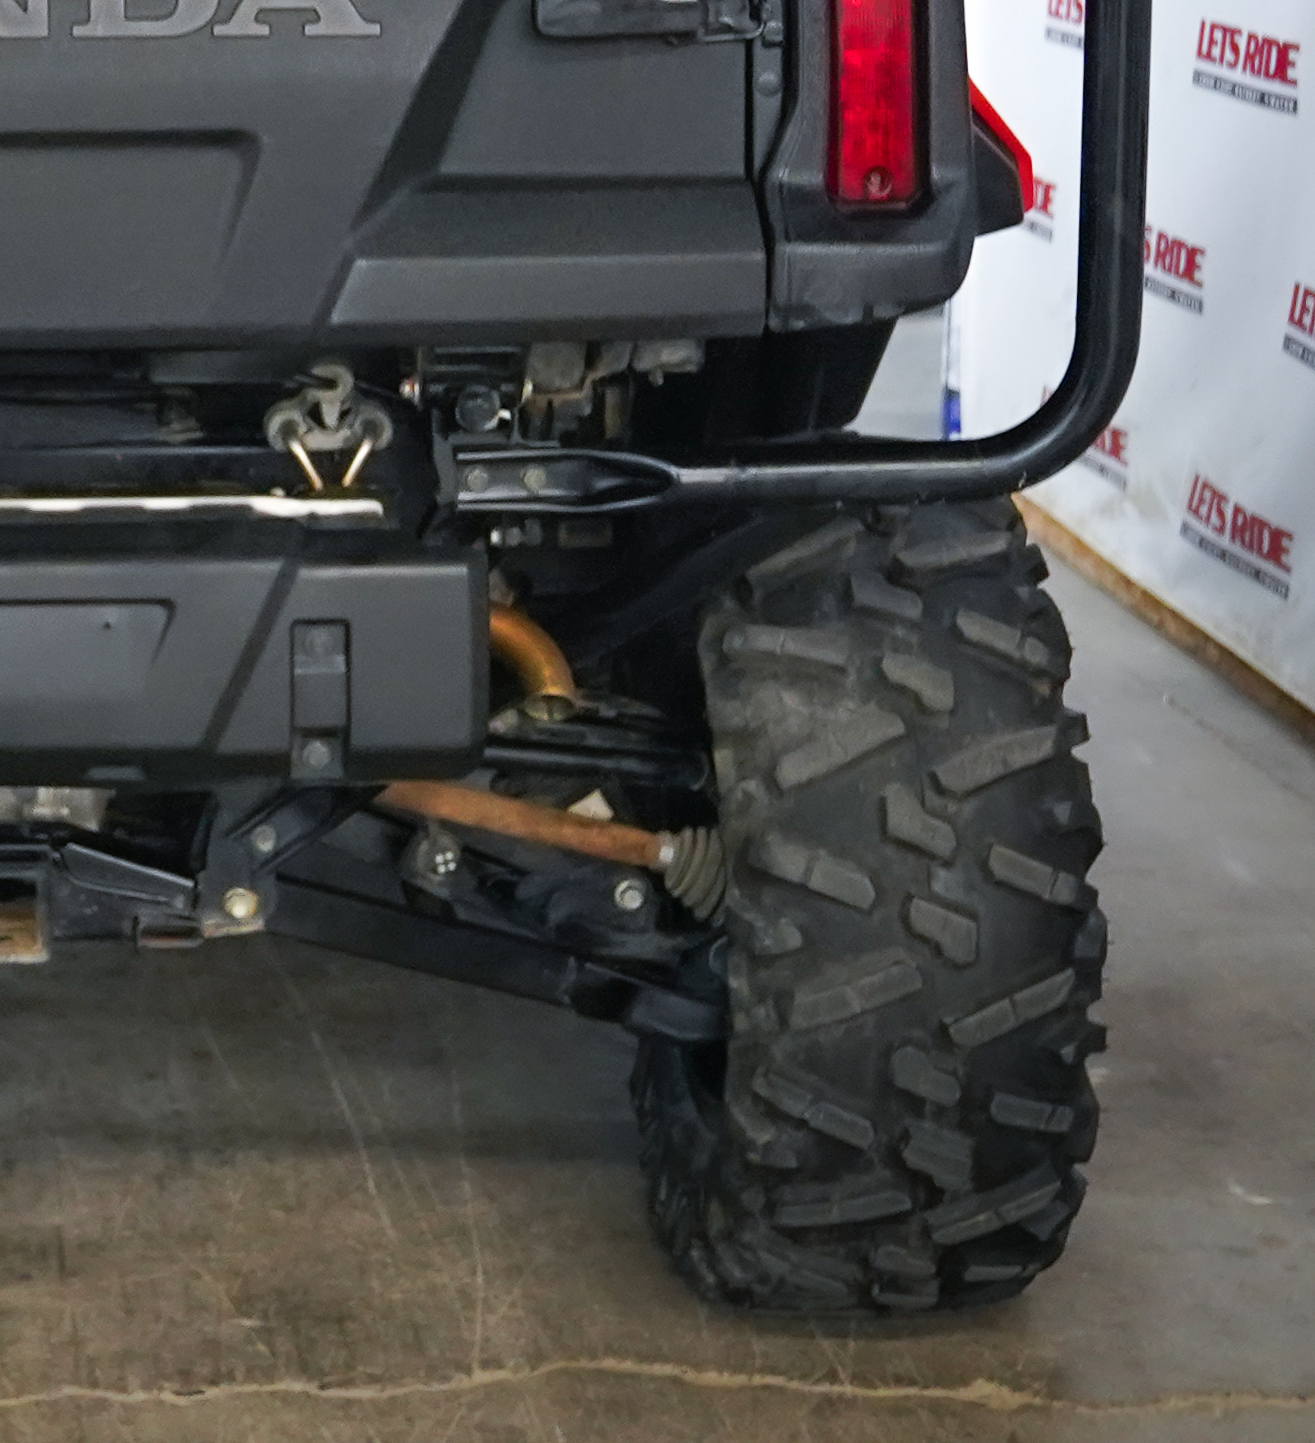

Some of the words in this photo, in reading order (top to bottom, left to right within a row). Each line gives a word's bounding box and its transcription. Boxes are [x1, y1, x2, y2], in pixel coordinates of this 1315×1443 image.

[1242, 32, 1301, 88] RIDE
[1154, 231, 1206, 289] RIDE
[1288, 282, 1315, 336] LET
[1230, 503, 1294, 574] RIDE
